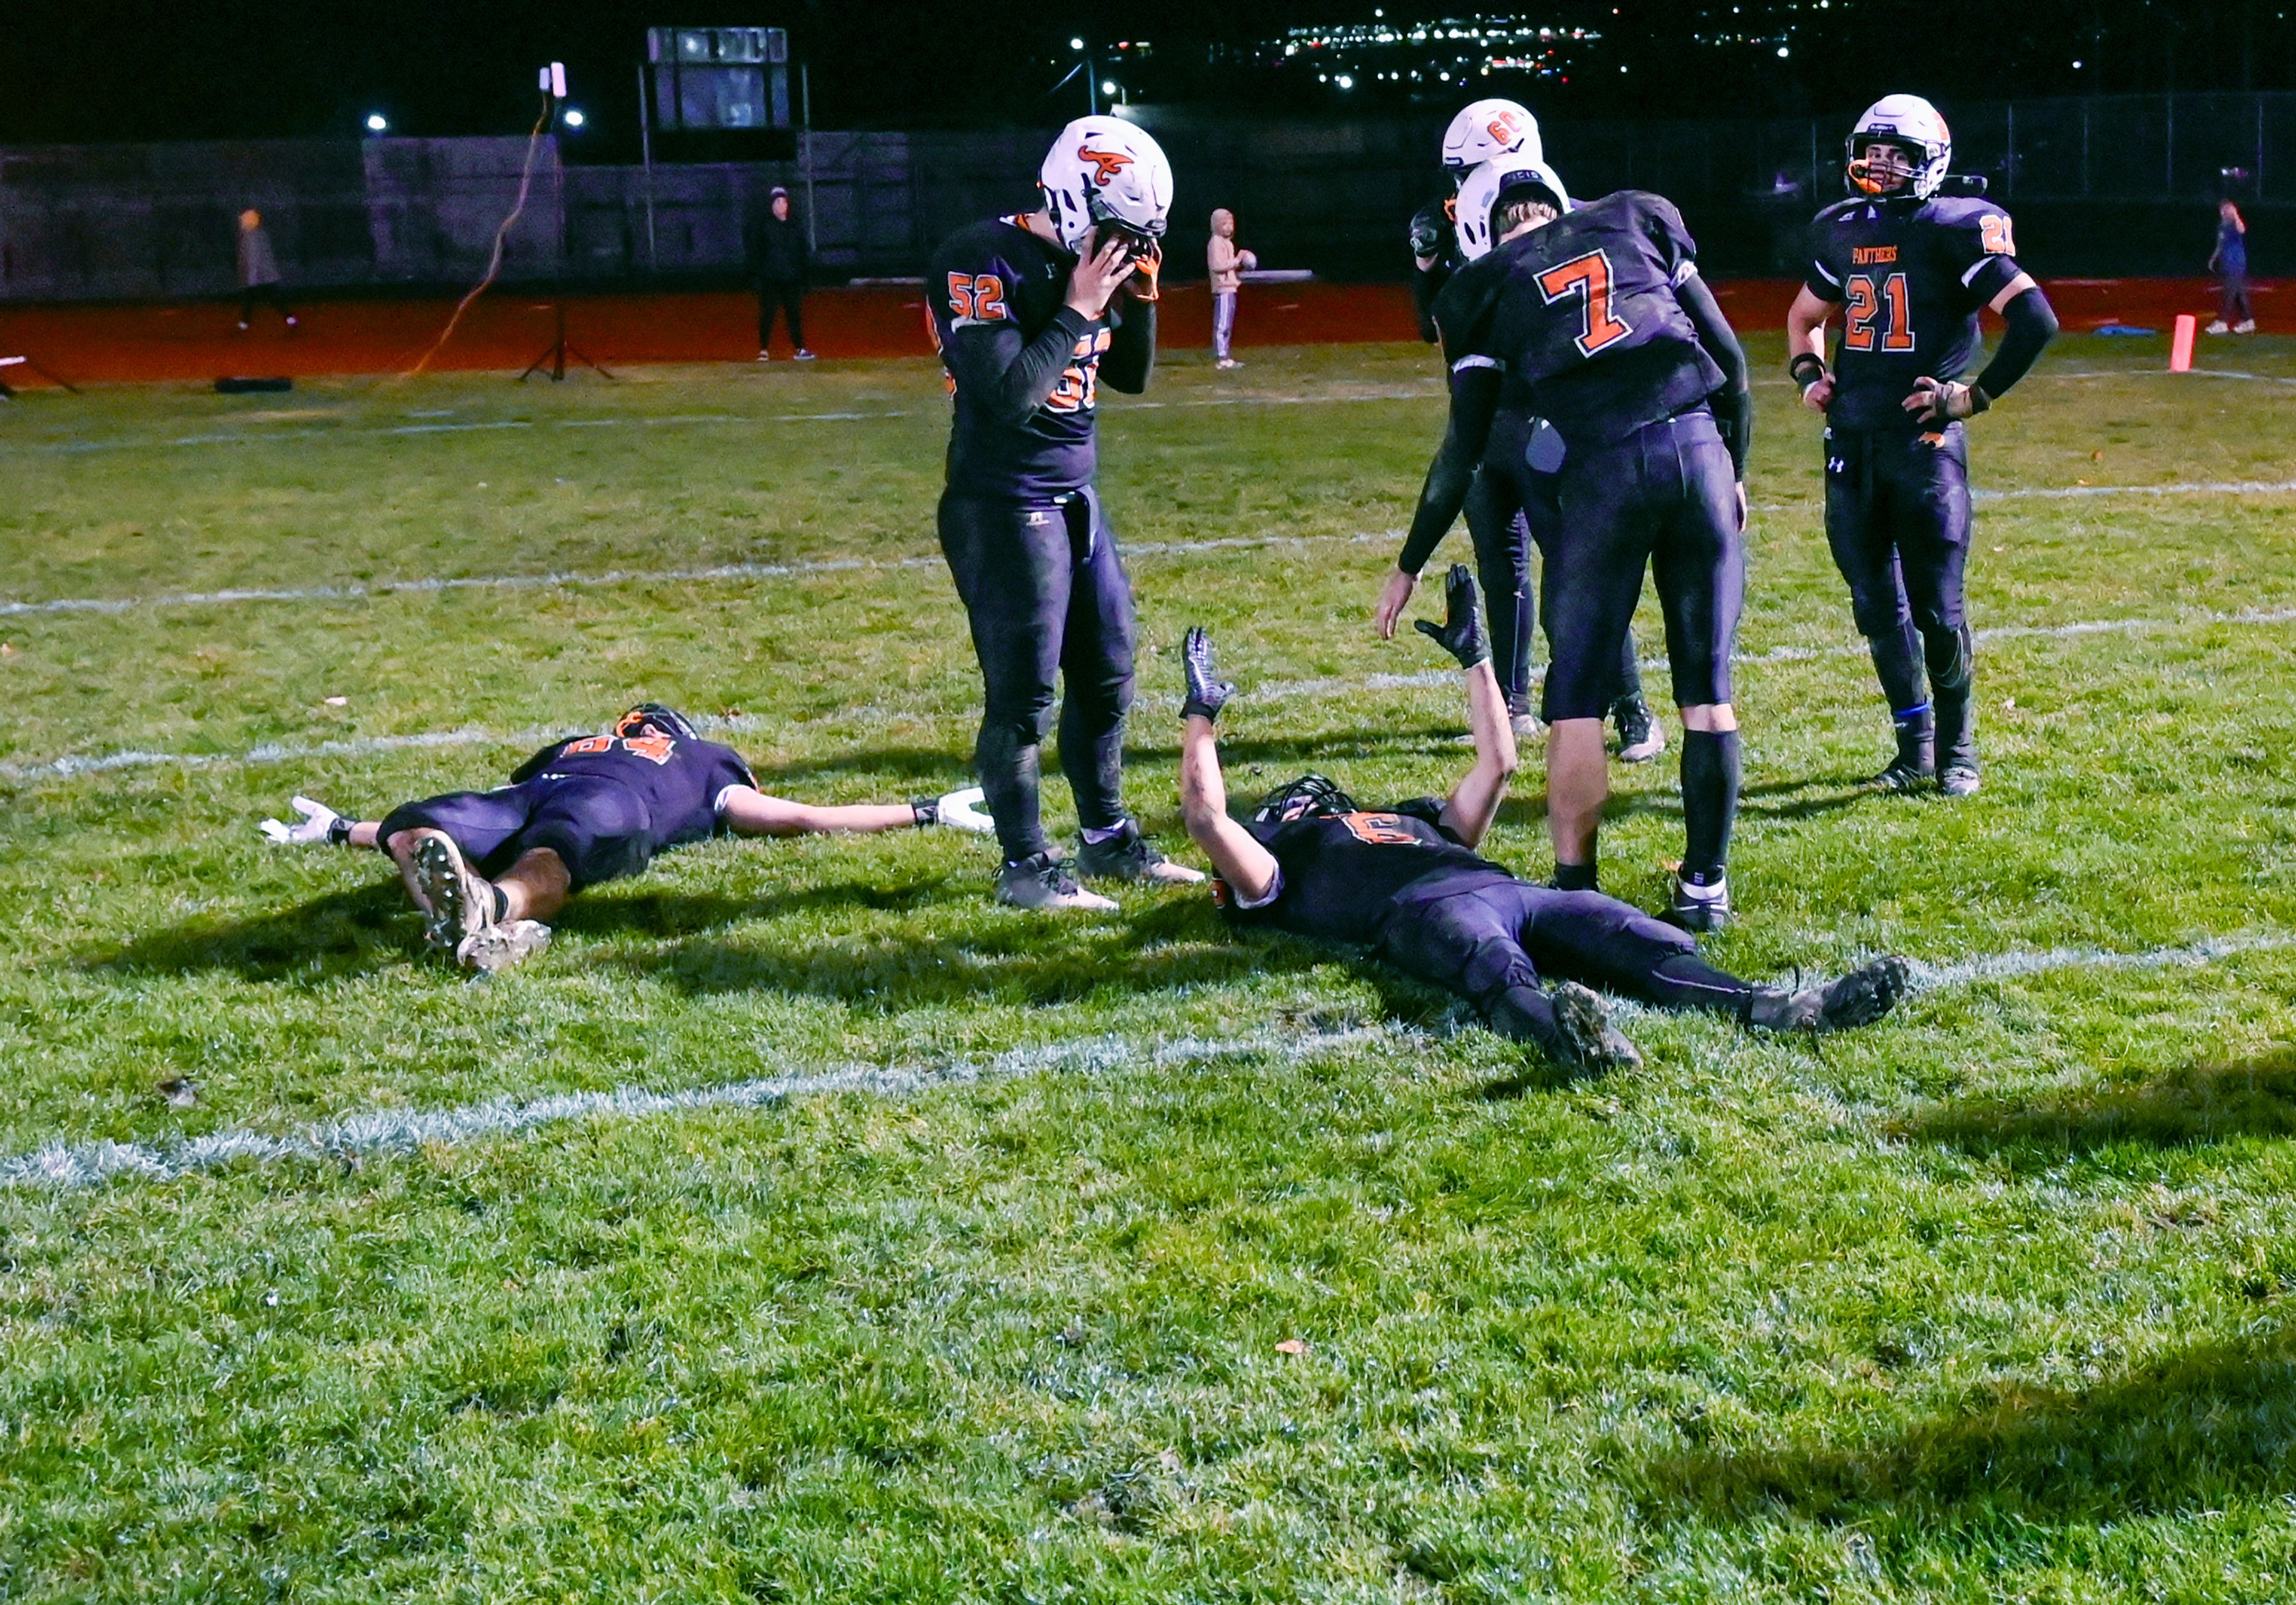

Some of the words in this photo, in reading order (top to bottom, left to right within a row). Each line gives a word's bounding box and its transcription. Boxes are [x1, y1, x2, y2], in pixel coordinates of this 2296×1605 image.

[1852, 244, 1898, 264] PANTHERS
[1979, 214, 2016, 257] 21
[948, 271, 1007, 320] 52
[1532, 247, 1634, 359] 7
[1845, 272, 1916, 352] 21
